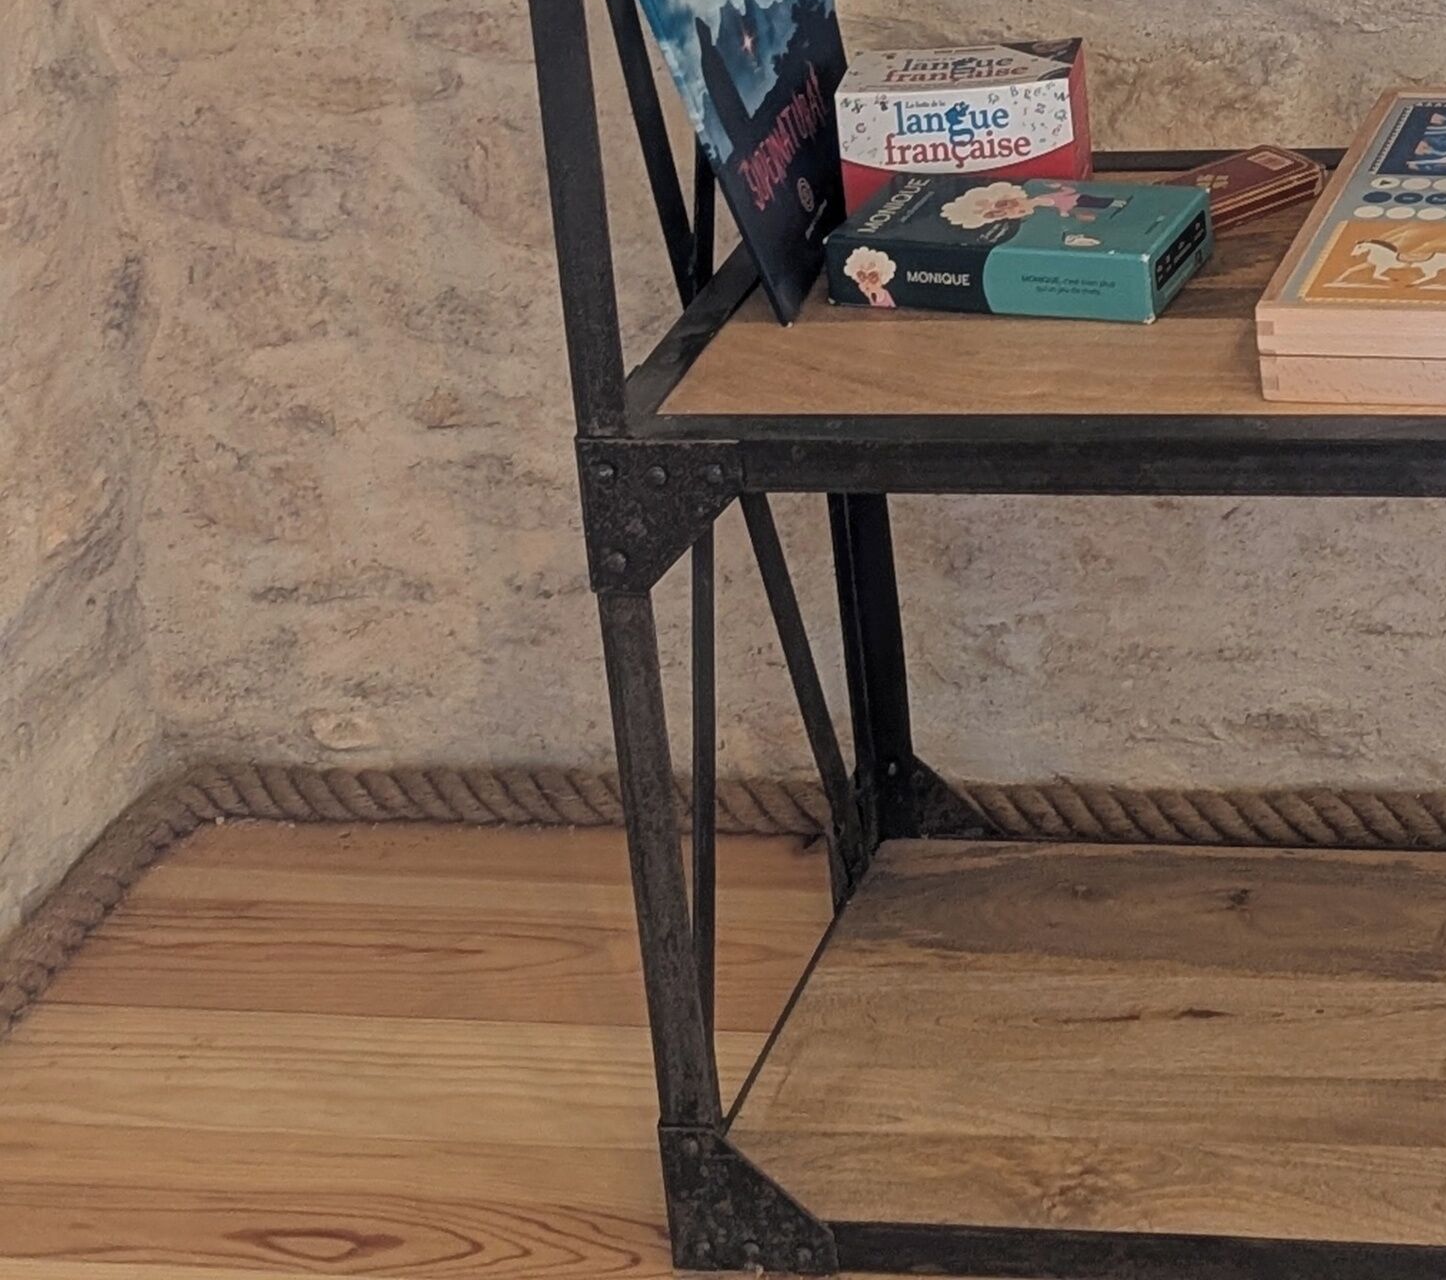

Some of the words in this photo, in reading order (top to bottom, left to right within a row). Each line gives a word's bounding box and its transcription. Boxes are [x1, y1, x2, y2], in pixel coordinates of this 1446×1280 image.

[883, 65, 1029, 85] française
[902, 57, 1014, 76] langue
[893, 101, 1010, 148] langue
[884, 130, 1031, 169] française
[857, 178, 931, 233] MONIQUE
[907, 271, 971, 286] MONIQUE
